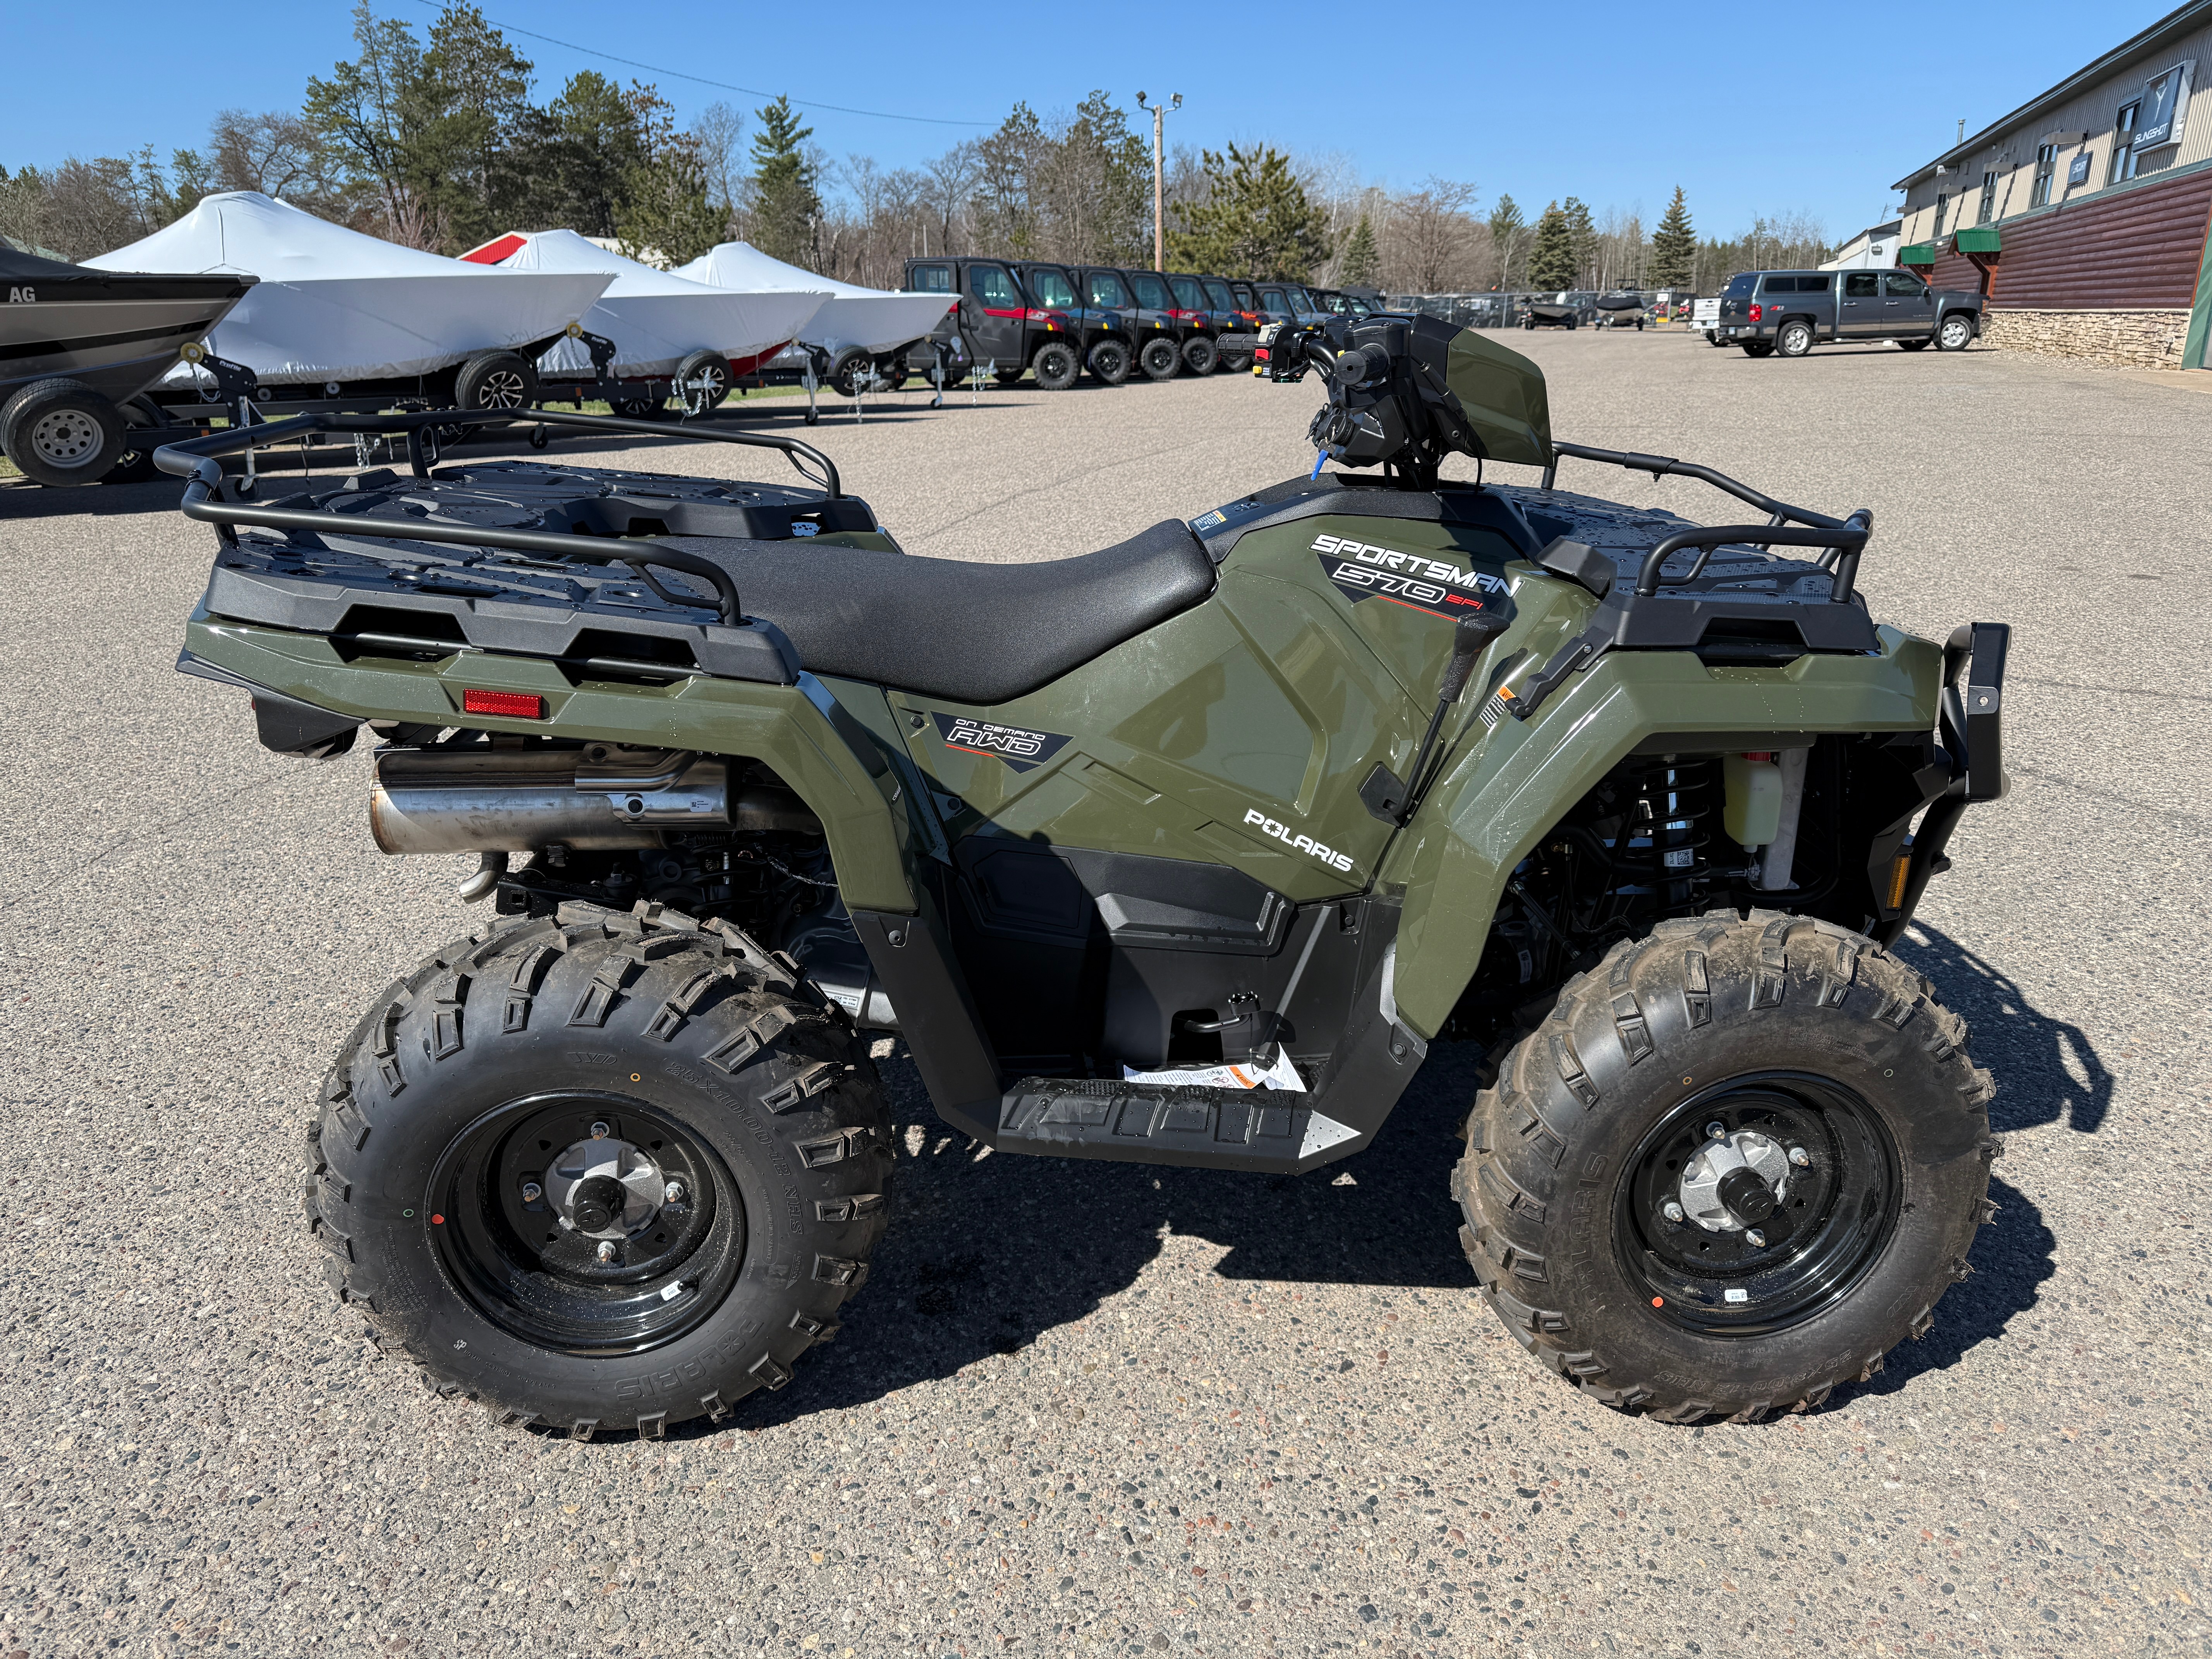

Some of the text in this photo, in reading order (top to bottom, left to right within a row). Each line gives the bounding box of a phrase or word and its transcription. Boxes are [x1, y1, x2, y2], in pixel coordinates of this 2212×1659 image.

[2134, 122, 2168, 144] SLINGSHOT
[9, 287, 36, 302] AG
[1311, 534, 1522, 597] SPORTSMAN
[1332, 563, 1483, 610] 570 EFI
[947, 726, 1042, 756] AWD
[955, 719, 1046, 740] ON DEMAND
[1243, 808, 1354, 872] POLARIS
[615, 1310, 764, 1401] POLARIS
